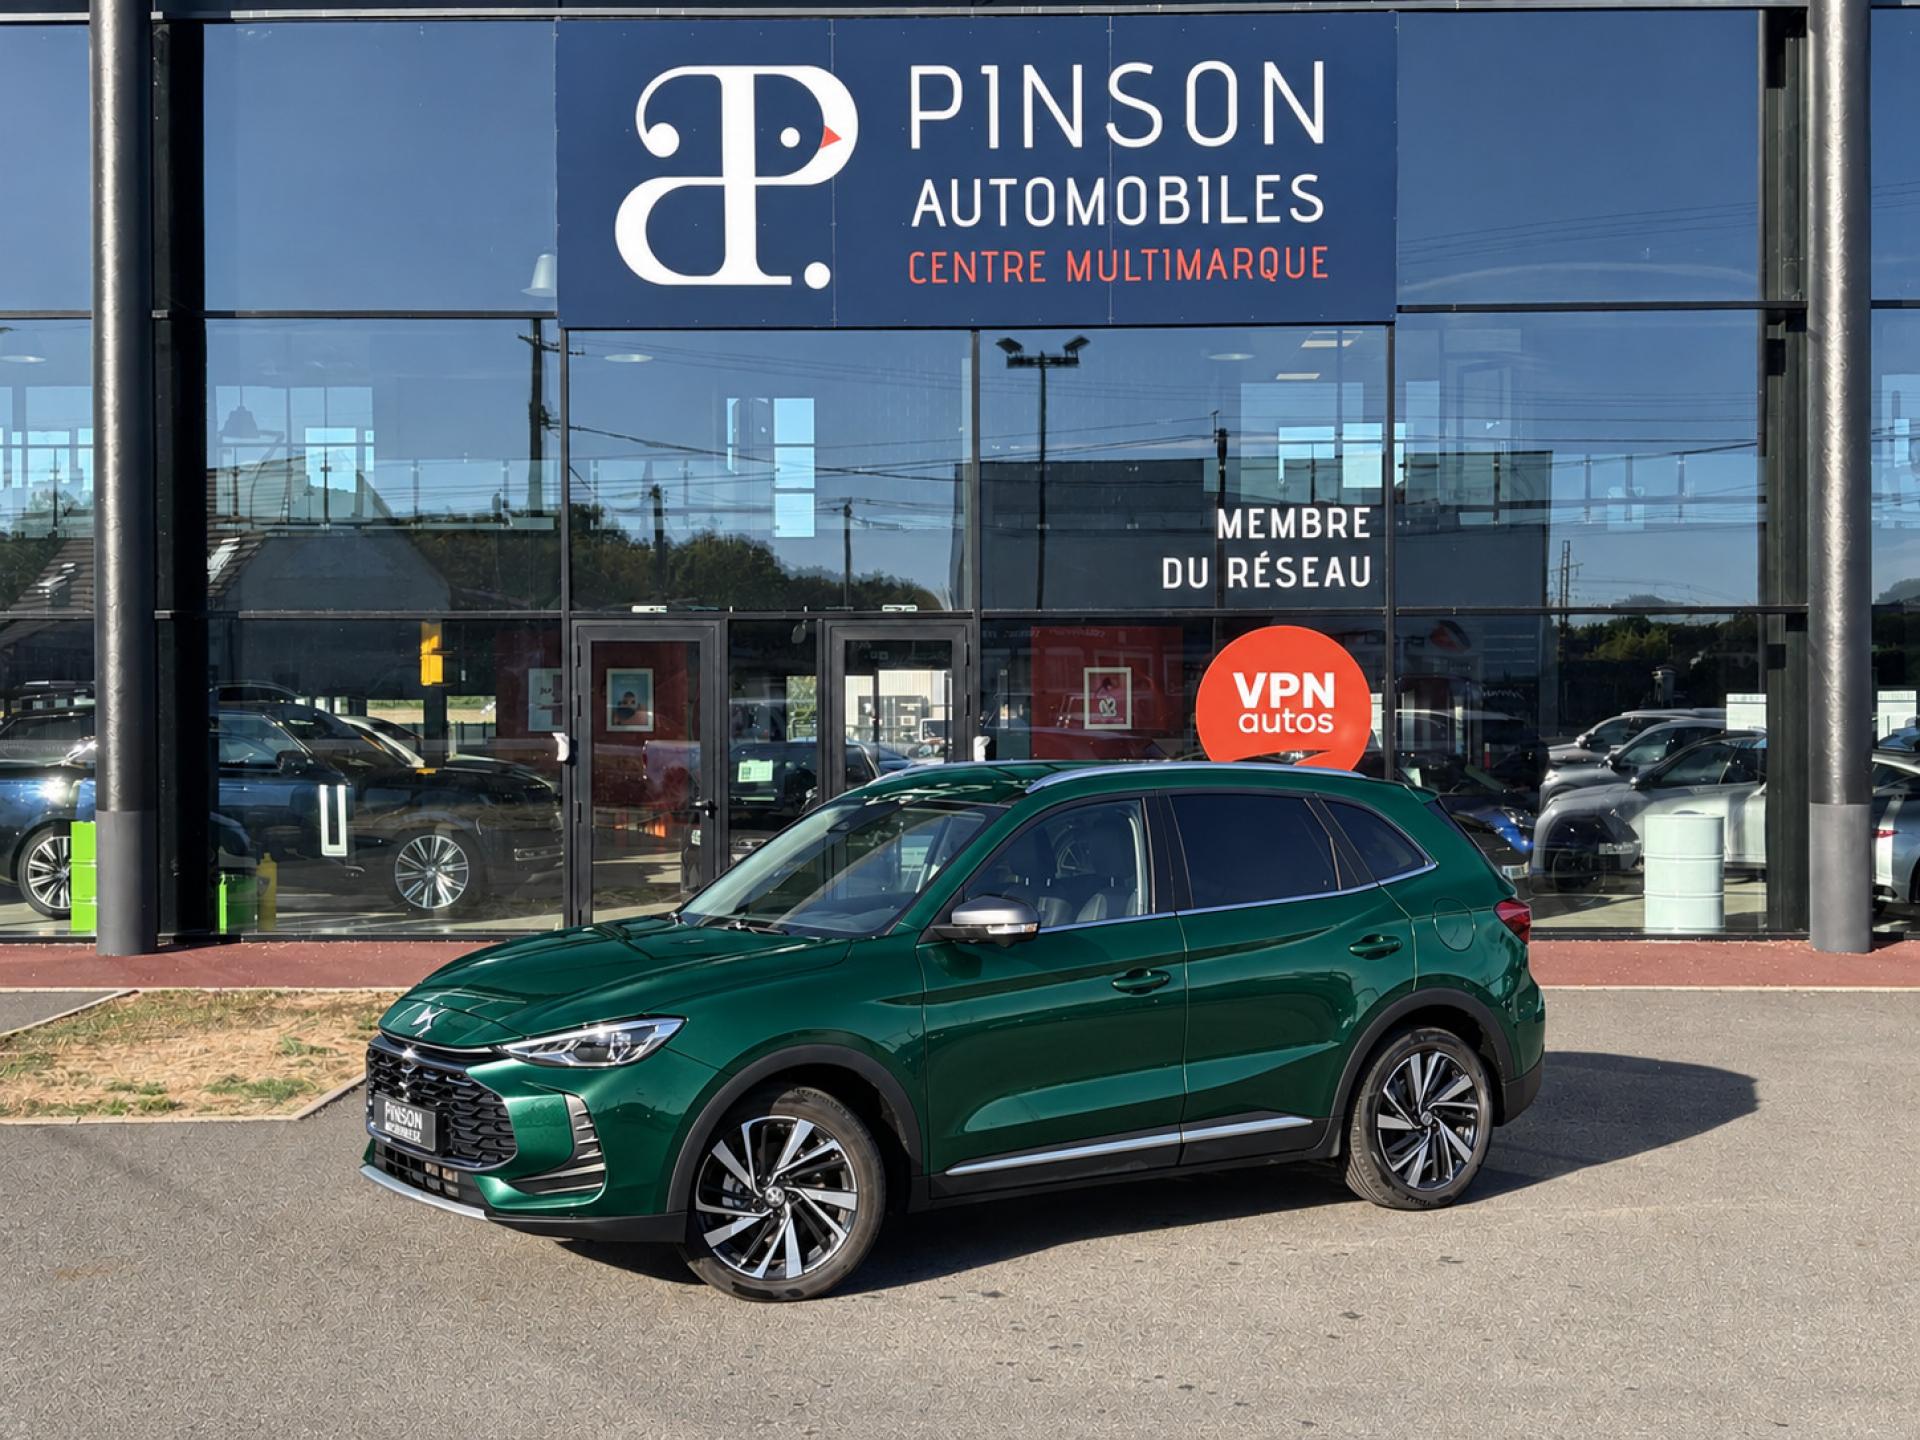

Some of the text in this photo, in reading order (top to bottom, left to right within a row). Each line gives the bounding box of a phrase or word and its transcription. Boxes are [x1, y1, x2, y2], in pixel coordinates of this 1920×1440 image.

[910, 60, 1325, 150] PINSON
[911, 173, 1324, 228] AUTOMOBILES
[910, 246, 1328, 284] CENTRE MULTIMARQUE
[1217, 507, 1371, 539] MEMBRE
[1162, 551, 1371, 589] DU RÉSEAU
[1232, 671, 1335, 708] VPN
[1238, 708, 1335, 734] autos
[384, 1101, 423, 1131] PINSON
